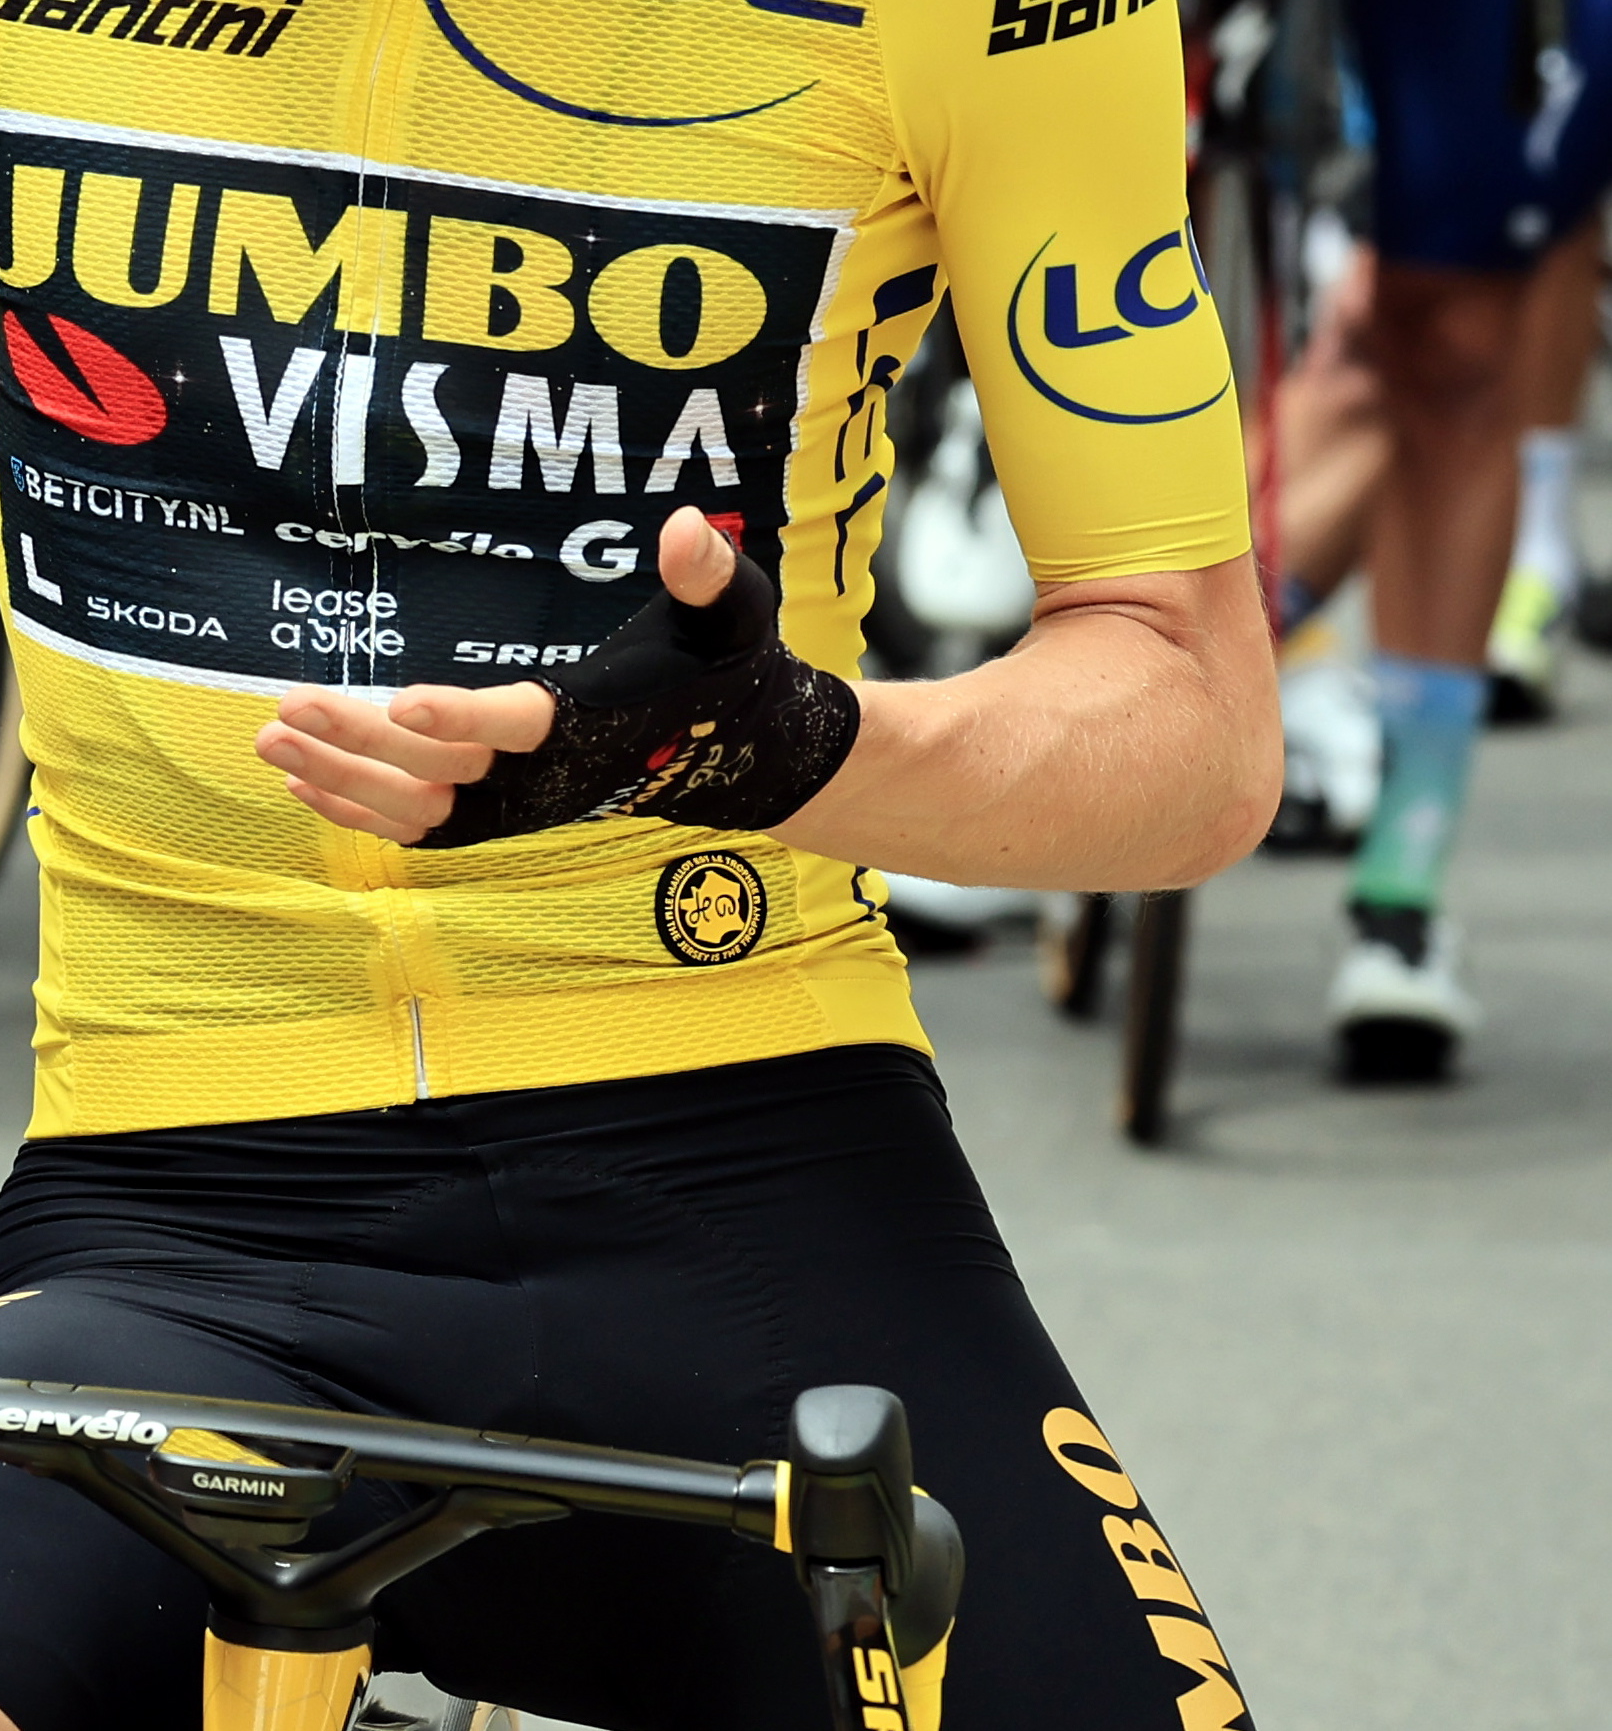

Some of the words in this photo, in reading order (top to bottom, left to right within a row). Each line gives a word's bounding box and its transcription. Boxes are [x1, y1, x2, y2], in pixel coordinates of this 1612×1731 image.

[218, 335, 740, 495] VISMA
[25, 465, 245, 536] BETCITY.NL
[271, 580, 398, 620] lease
[453, 640, 600, 666] SRA
[192, 1472, 285, 1498] GARMIN
